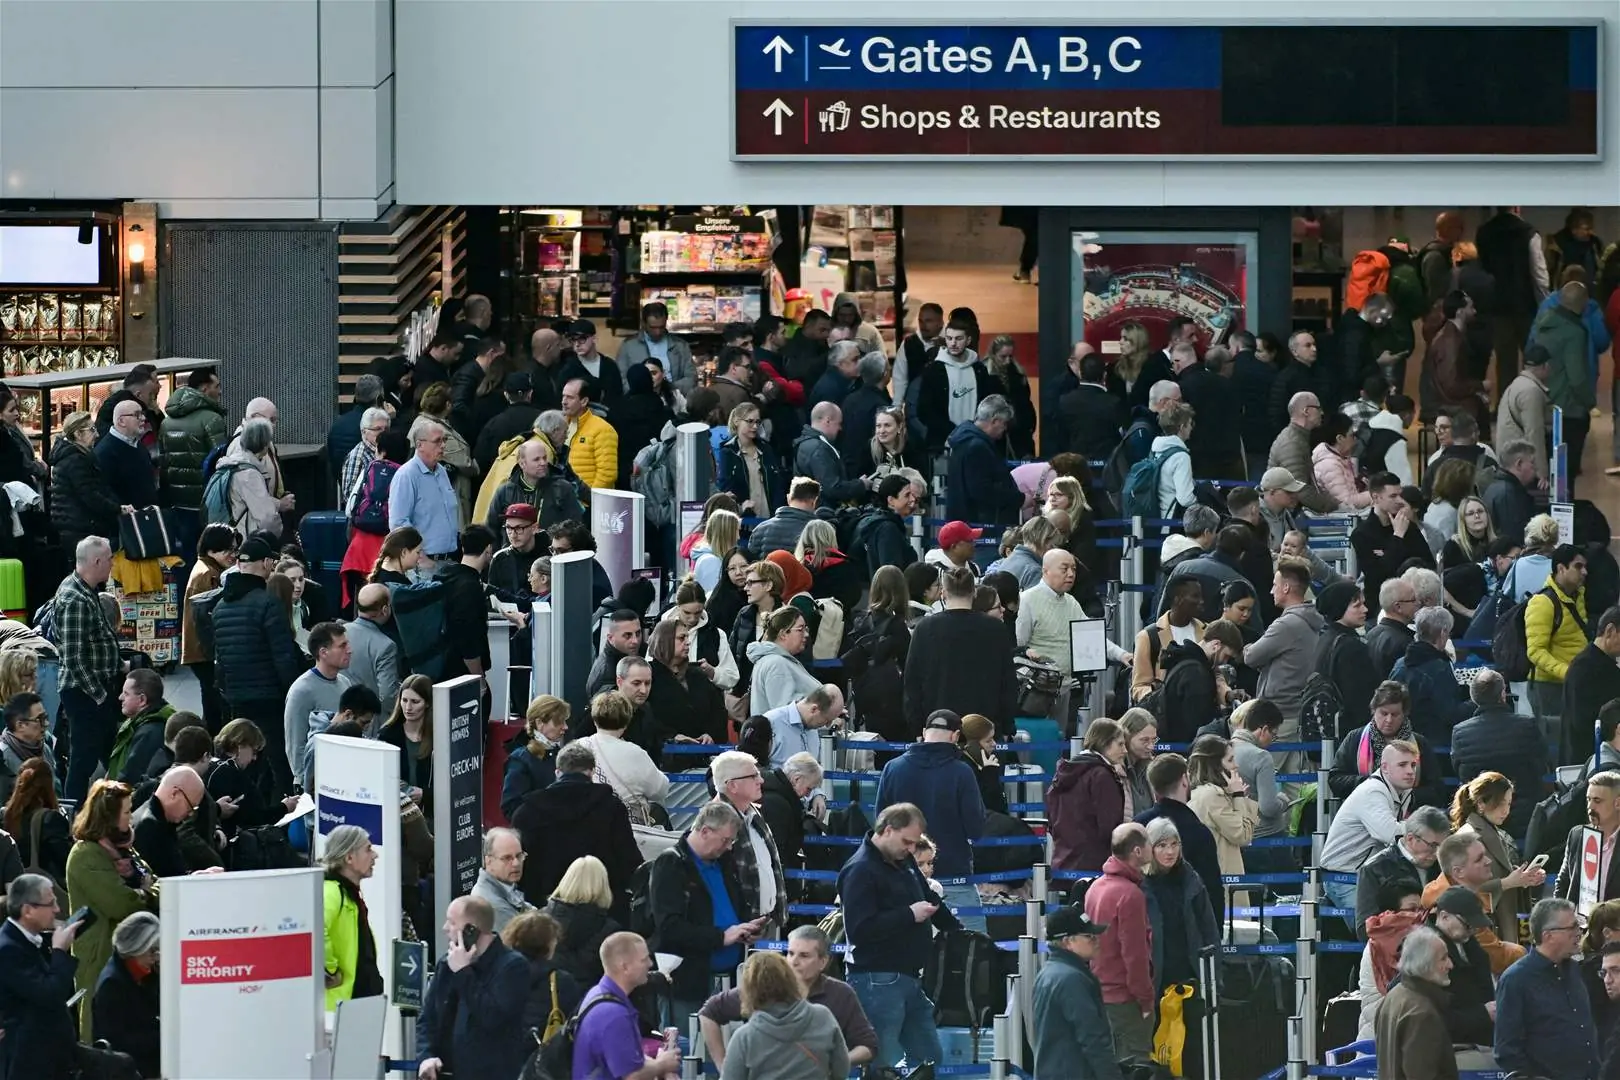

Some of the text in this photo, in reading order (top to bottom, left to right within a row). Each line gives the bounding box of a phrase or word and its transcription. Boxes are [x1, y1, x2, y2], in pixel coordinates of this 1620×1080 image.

[861, 37, 993, 73] Gates
[860, 103, 1161, 136] Shops & Restaurants
[704, 217, 731, 225] Unsere
[695, 223, 740, 233] Empfehlung
[139, 642, 169, 651] COFFEE
[995, 742, 1009, 751] DUS
[1157, 743, 1171, 751] DUS
[451, 756, 479, 778] CHECK-IN
[458, 812, 471, 827] CLUB
[456, 825, 475, 841] EUROPE
[952, 877, 967, 885] DUS
[1225, 875, 1240, 883] DUS
[278, 921, 298, 931] KLM
[1223, 945, 1238, 953] DUS
[187, 955, 218, 968] SKY
[187, 965, 254, 978] PRIORITY
